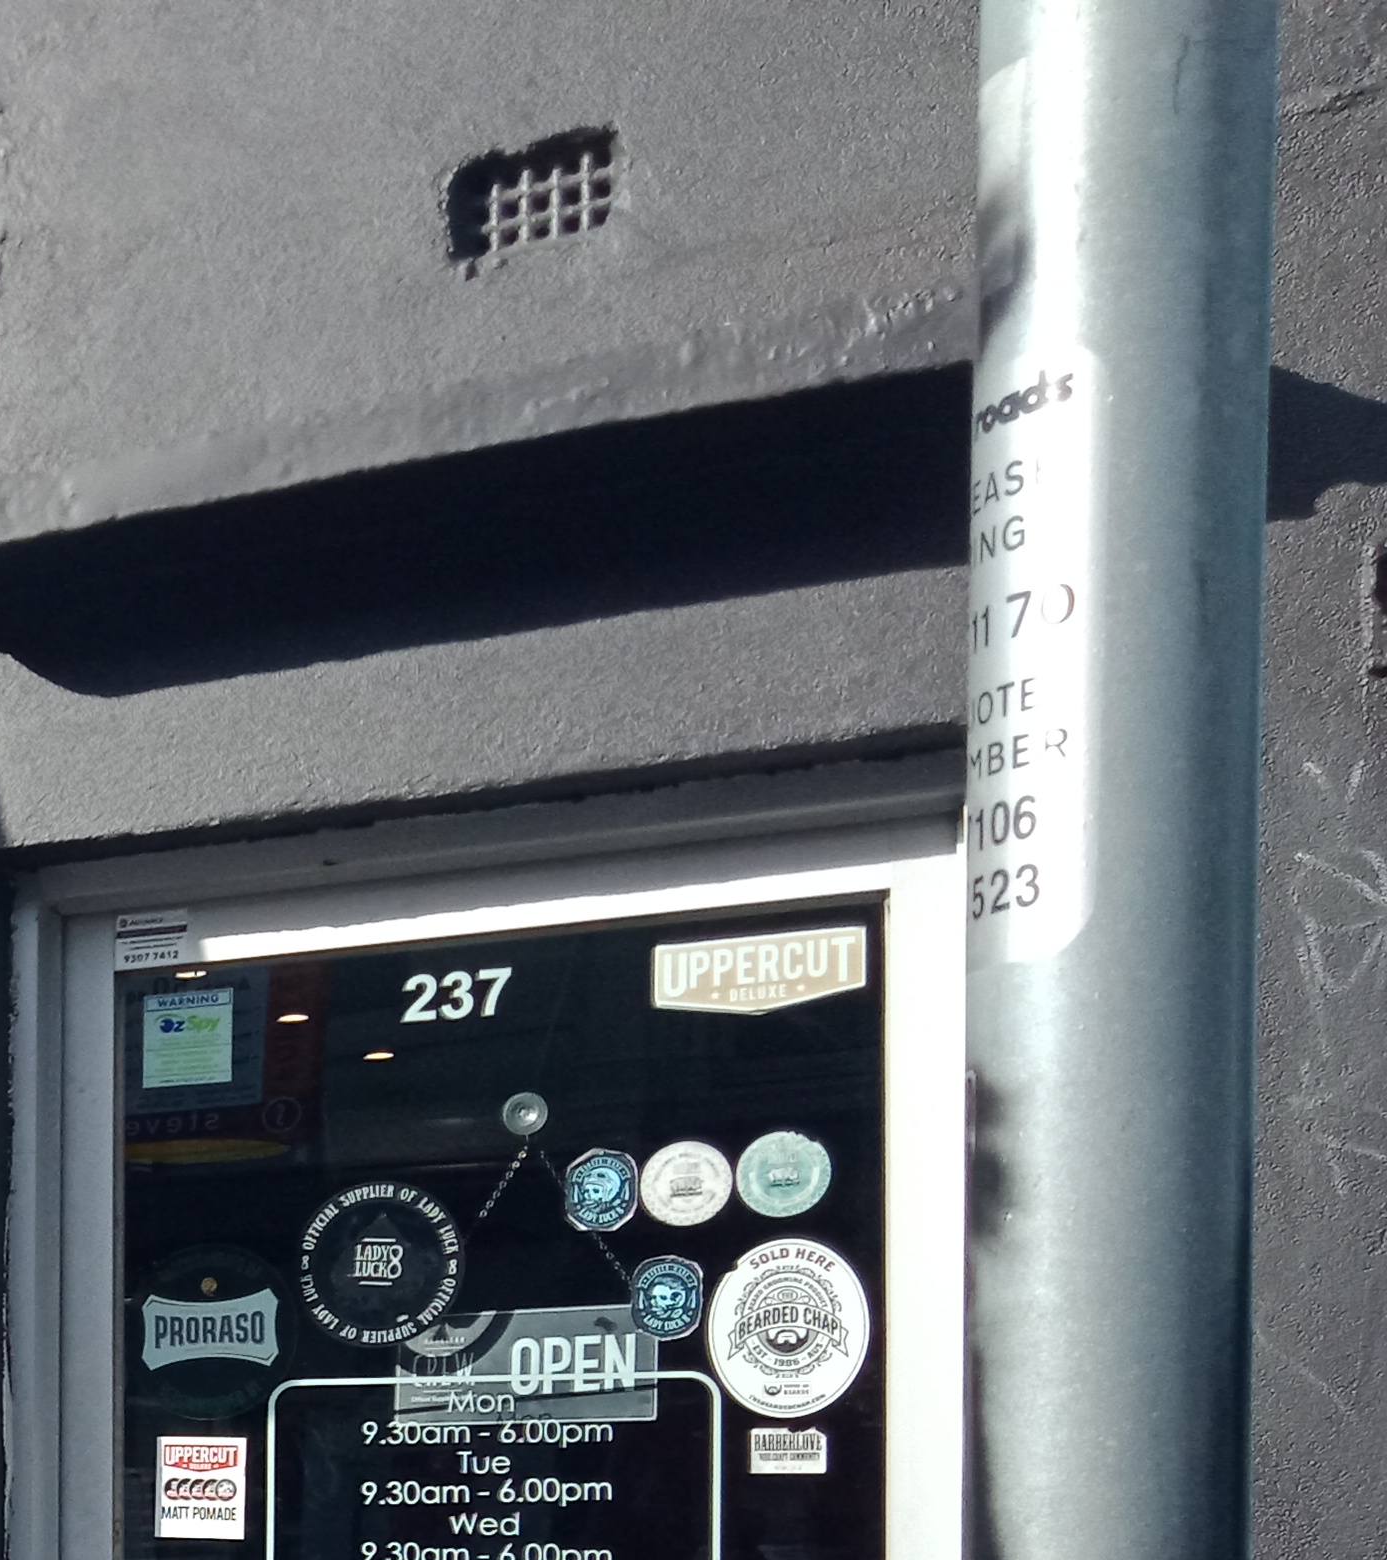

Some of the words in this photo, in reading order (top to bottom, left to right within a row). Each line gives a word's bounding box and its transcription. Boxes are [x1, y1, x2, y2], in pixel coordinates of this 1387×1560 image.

[972, 458, 1040, 516] EAS
[973, 678, 1035, 726] OTE
[972, 863, 1040, 920] 523
[663, 936, 856, 997] UPPERCUT
[157, 994, 220, 1008] WARNING
[400, 966, 513, 1025] 237
[729, 984, 787, 1002] DELUXE
[302, 1203, 340, 1251] OFFICIAL
[338, 1184, 395, 1207] SUPPLIER
[399, 1187, 419, 1203] OF
[417, 1197, 446, 1224] LADY
[437, 1224, 459, 1255] LUCK
[354, 1244, 390, 1261] LADY
[749, 1247, 789, 1270] SOLD
[794, 1247, 836, 1272] HERE
[353, 1261, 389, 1278] LUCK
[416, 1278, 456, 1325] OFFICIAL
[154, 1309, 266, 1349] PRORASO
[311, 1303, 340, 1331] LADY
[738, 1305, 799, 1340] BEARDED
[803, 1307, 840, 1337] CHAP
[339, 1324, 357, 1340] OF
[361, 1322, 418, 1344] SUPPLIER
[509, 1332, 636, 1397] OPEN
[447, 1389, 516, 1415] Mon
[360, 1420, 471, 1446] 9.30am
[497, 1419, 613, 1448] 6.00pm
[754, 1433, 822, 1451] BARBERLOVE
[166, 1446, 238, 1466] UPPERCUT
[456, 1450, 511, 1475] Tue
[360, 1481, 471, 1506] 9.30am
[496, 1478, 613, 1507] 6.00pm
[161, 1506, 189, 1520] MATT
[192, 1506, 237, 1521] POMADE
[449, 1511, 520, 1537] Wed
